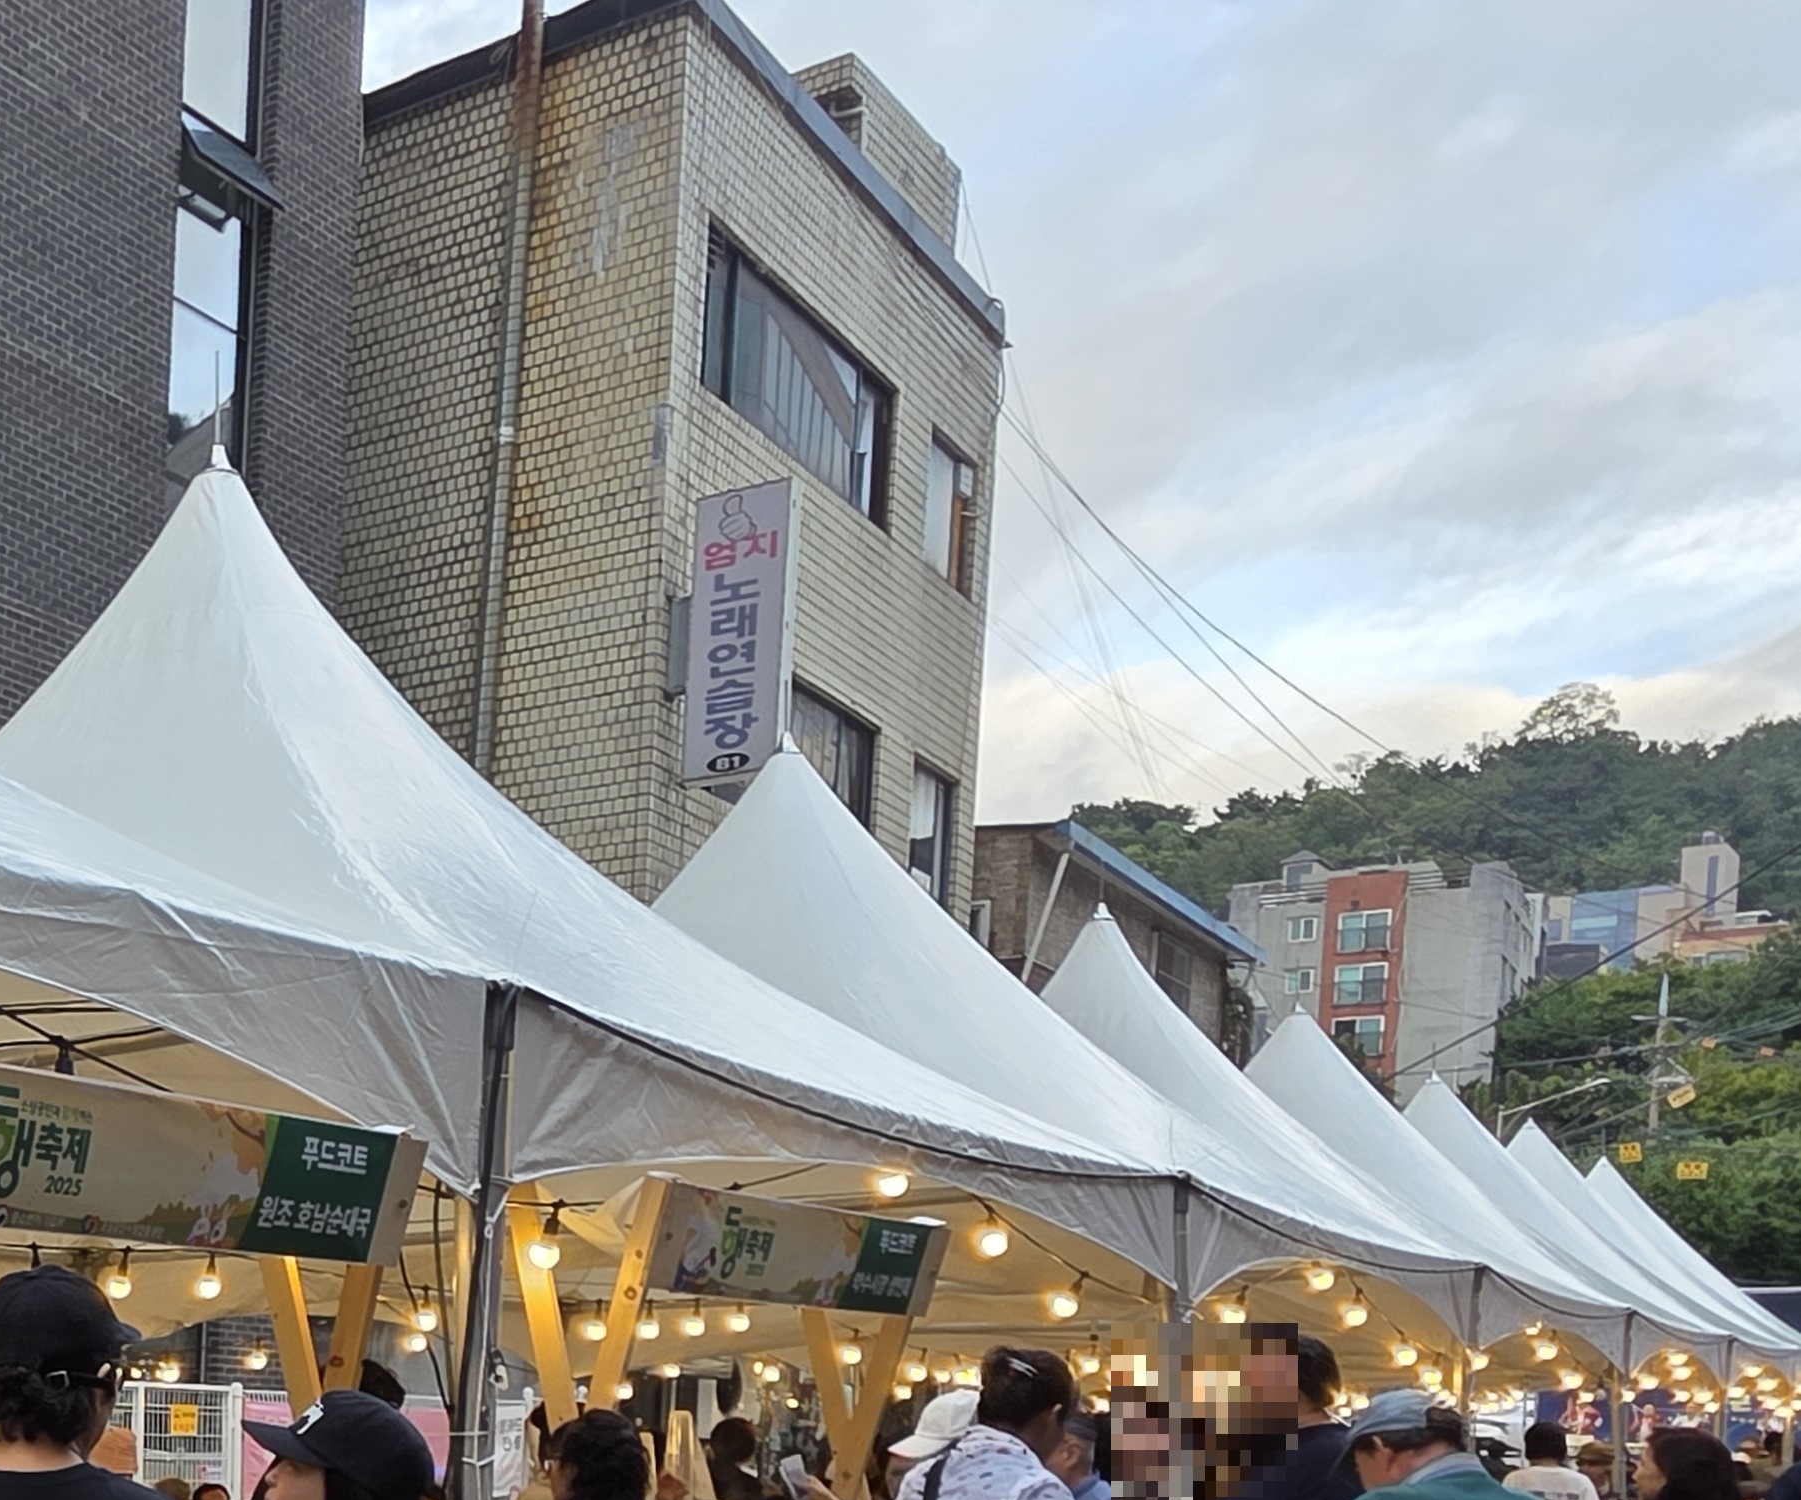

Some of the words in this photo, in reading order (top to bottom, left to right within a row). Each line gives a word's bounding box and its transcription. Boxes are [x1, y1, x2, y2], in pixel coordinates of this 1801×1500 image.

[703, 530, 778, 571] 엄지
[704, 574, 760, 750] 노래연습장
[715, 756, 742, 770] B1
[301, 1136, 368, 1175] 푸드코트
[44, 1175, 83, 1197] 2025
[257, 1195, 295, 1228] 원조
[293, 1200, 372, 1238] 호남순대국
